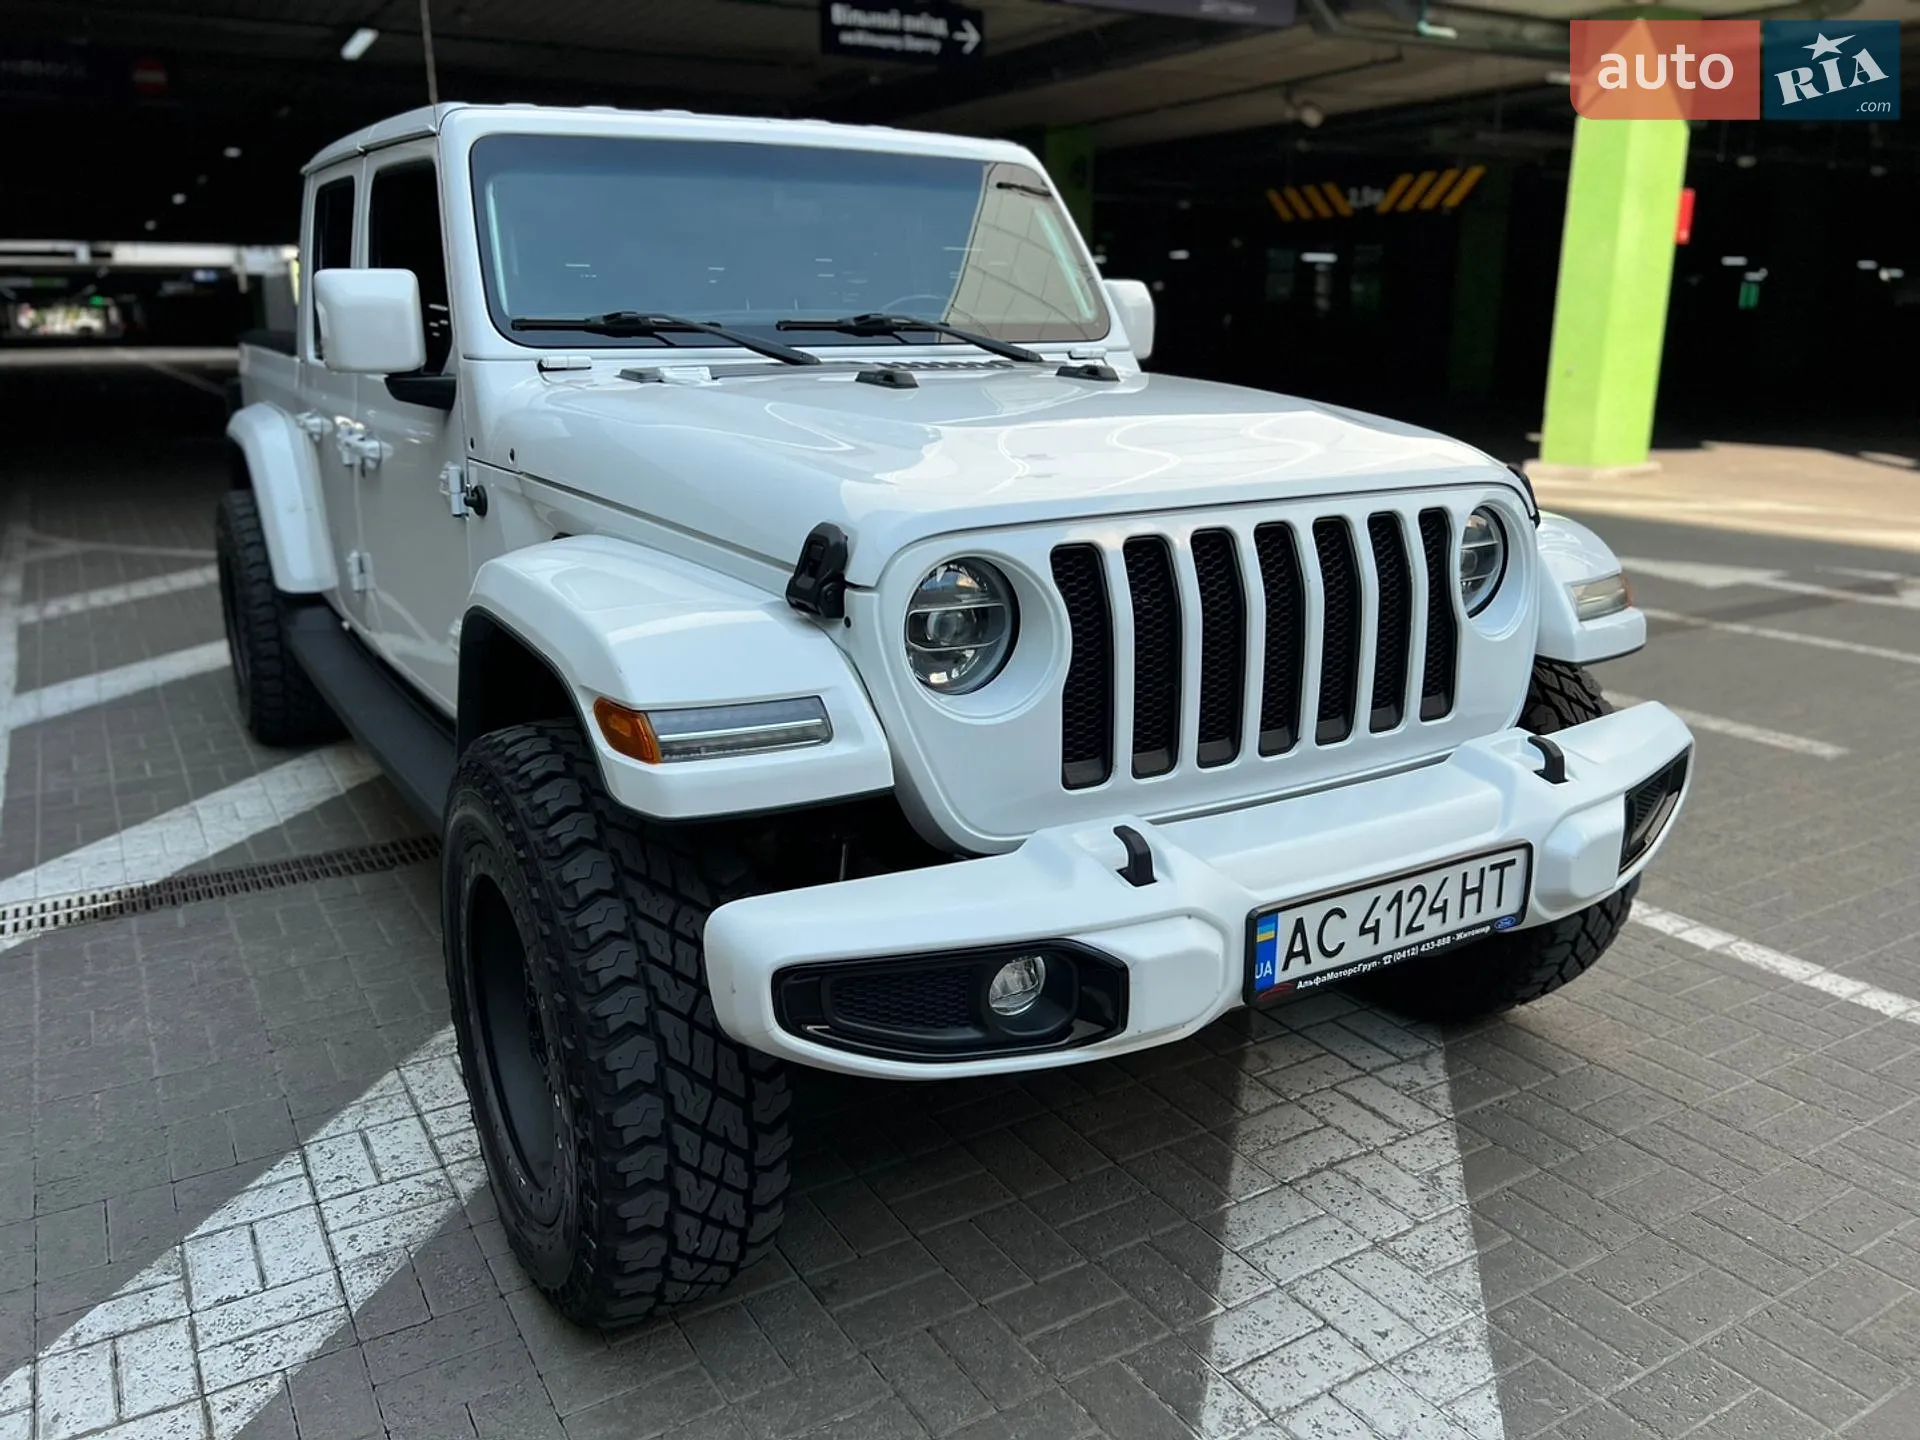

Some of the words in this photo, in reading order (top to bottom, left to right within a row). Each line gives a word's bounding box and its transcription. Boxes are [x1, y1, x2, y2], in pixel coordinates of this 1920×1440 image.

[1281, 907, 1347, 971] AC
[1358, 876, 1449, 946] 4124
[1458, 858, 1517, 919] HT
[1255, 960, 1273, 979] UA
